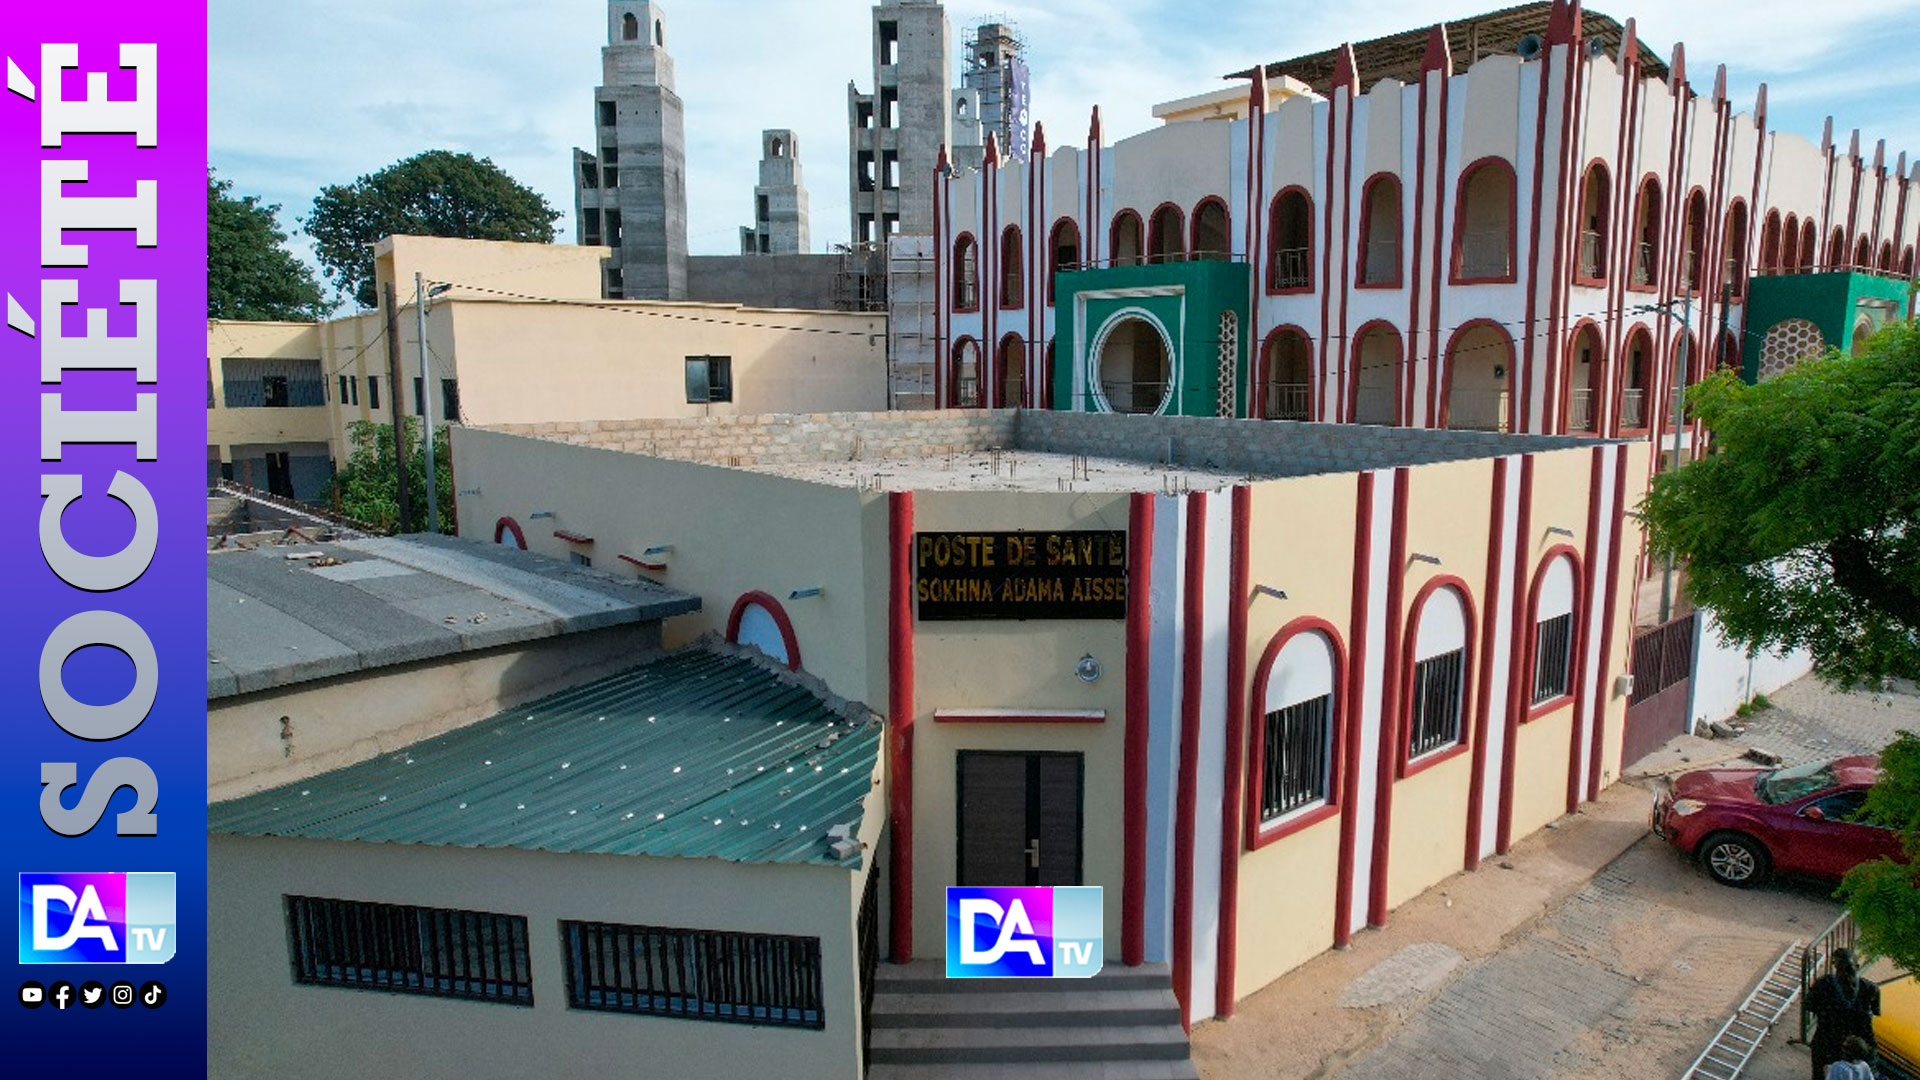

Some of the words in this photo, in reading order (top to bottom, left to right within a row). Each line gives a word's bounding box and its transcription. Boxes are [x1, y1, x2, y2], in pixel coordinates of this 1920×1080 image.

[919, 535, 995, 567] POSTE
[1007, 535, 1036, 566] DE
[918, 577, 993, 602] SOKHNA
[1002, 577, 1064, 602] ADAMA
